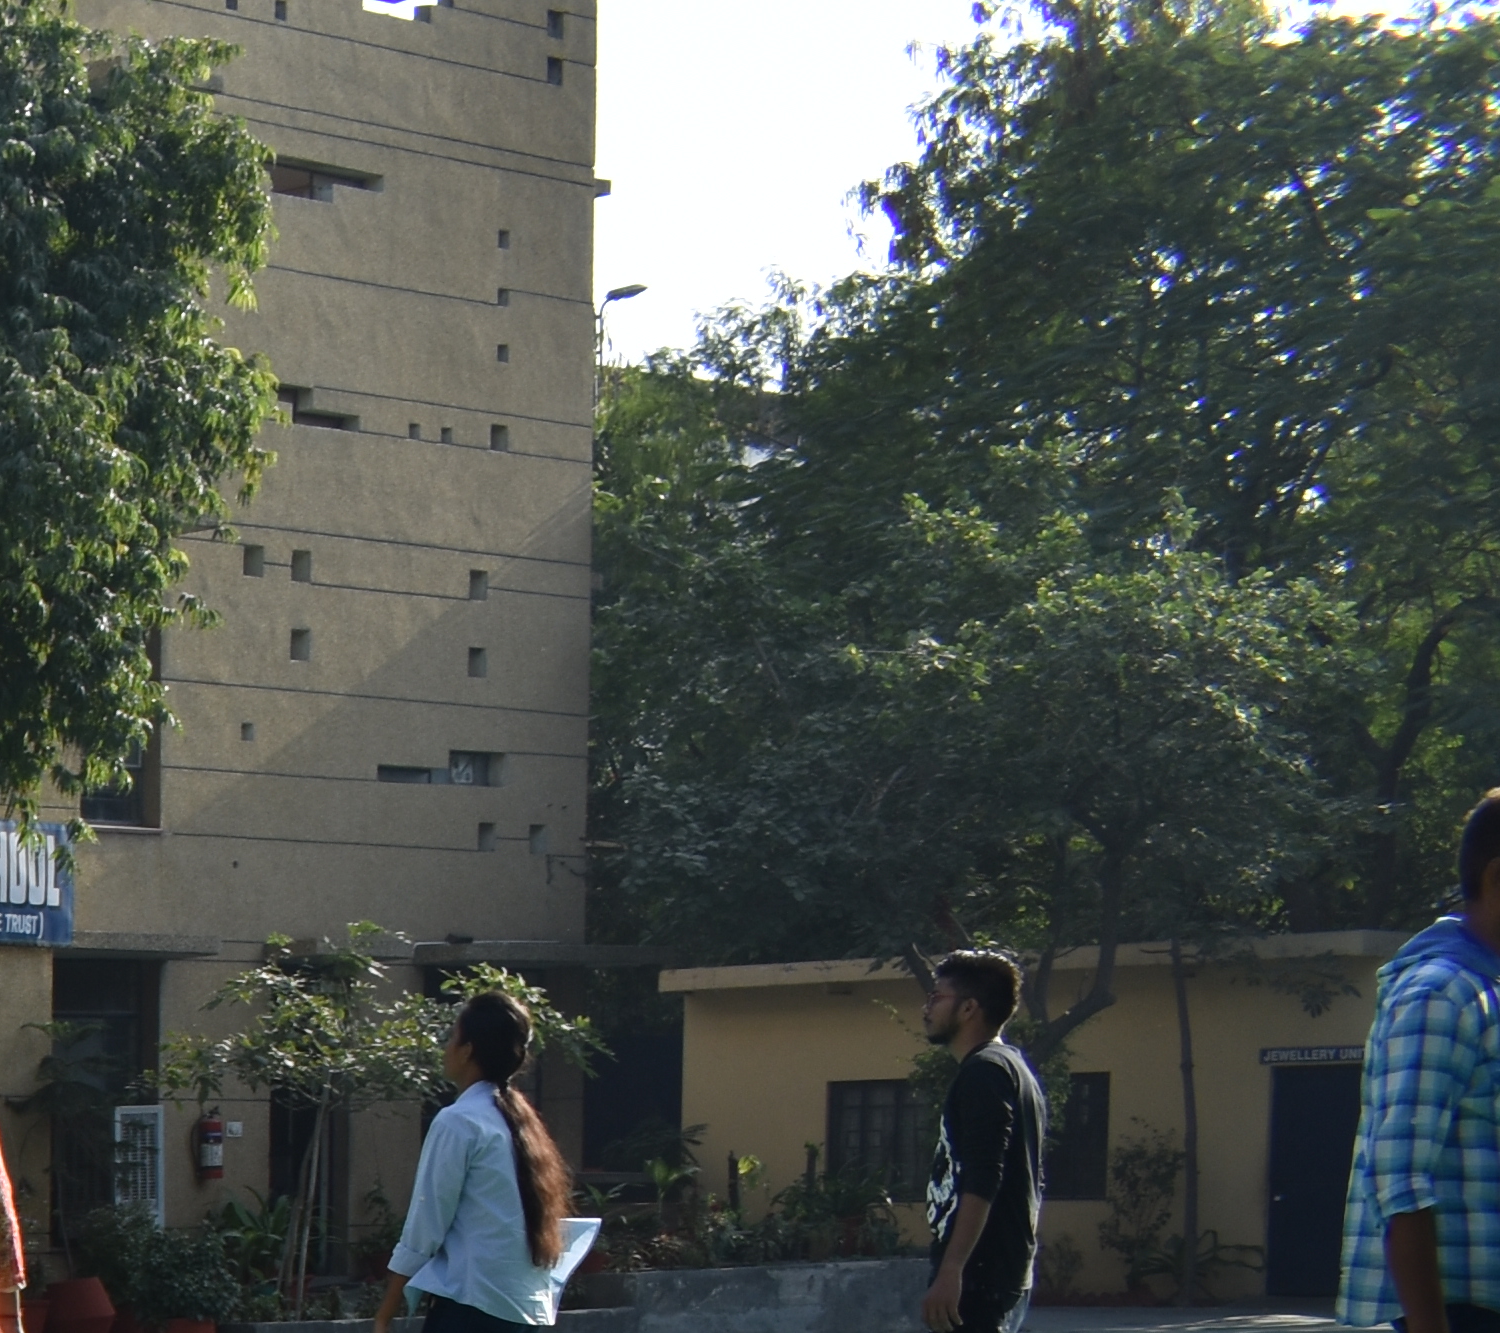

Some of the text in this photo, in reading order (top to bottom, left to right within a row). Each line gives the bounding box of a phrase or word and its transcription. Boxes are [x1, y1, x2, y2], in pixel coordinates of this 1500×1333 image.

[5, 911, 44, 939] TRUST)
[1263, 1048, 1365, 1062] JEWELLERY UNI
